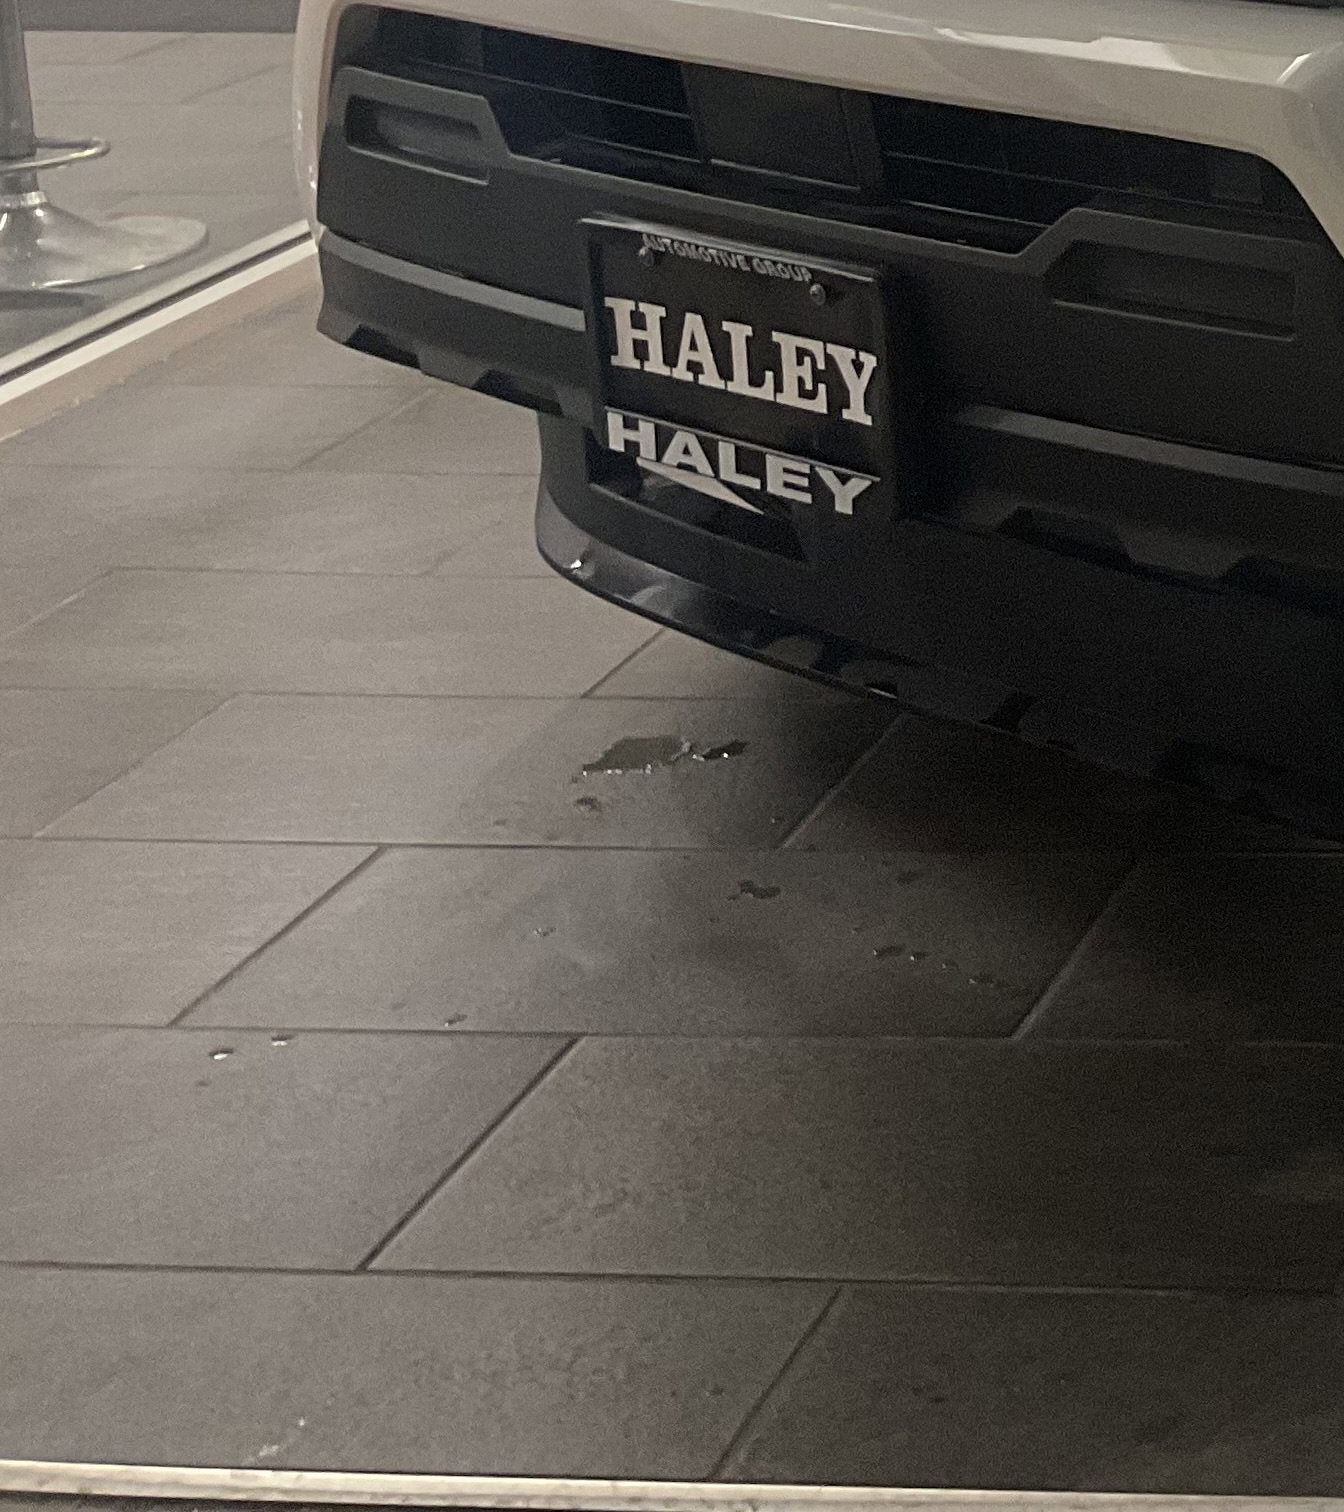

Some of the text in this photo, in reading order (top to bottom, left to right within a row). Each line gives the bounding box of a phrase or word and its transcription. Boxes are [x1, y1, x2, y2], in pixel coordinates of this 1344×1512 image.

[642, 233, 812, 282] AUTOMOTIVE GROUP
[604, 296, 878, 426] HALEY
[606, 410, 873, 516] HALEY
